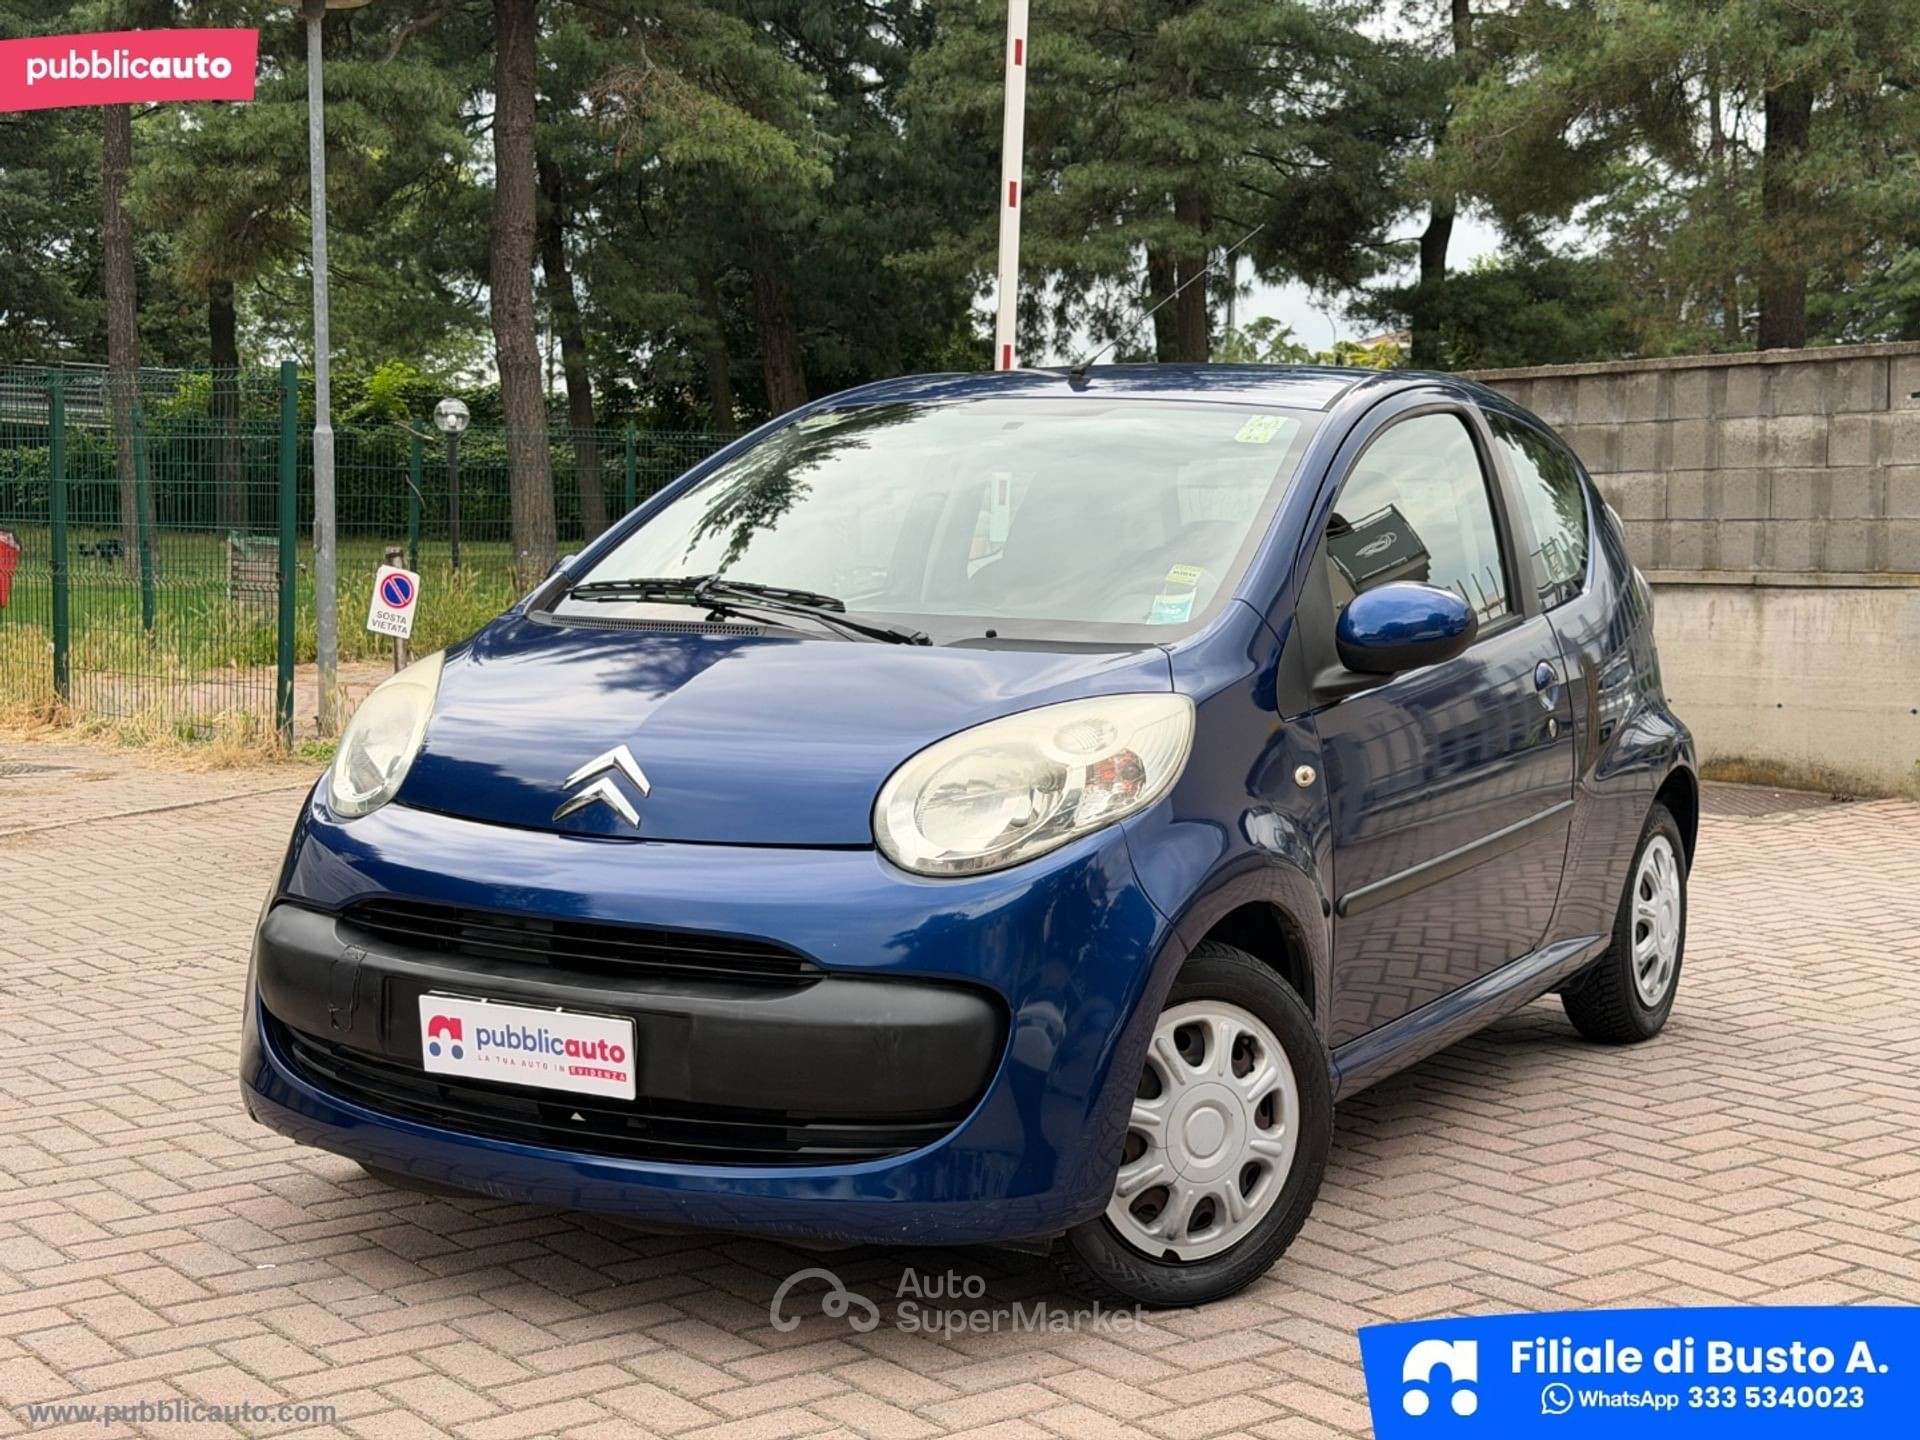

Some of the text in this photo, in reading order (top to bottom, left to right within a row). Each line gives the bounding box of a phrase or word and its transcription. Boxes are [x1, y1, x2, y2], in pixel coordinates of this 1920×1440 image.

[372, 619, 407, 633] VIETATA
[377, 611, 406, 624] SOSTA
[476, 1024, 625, 1064] pubblicauto
[496, 1056, 516, 1065] TUA
[522, 1060, 548, 1070] AUTO
[571, 1066, 626, 1081] EVIDENZA
